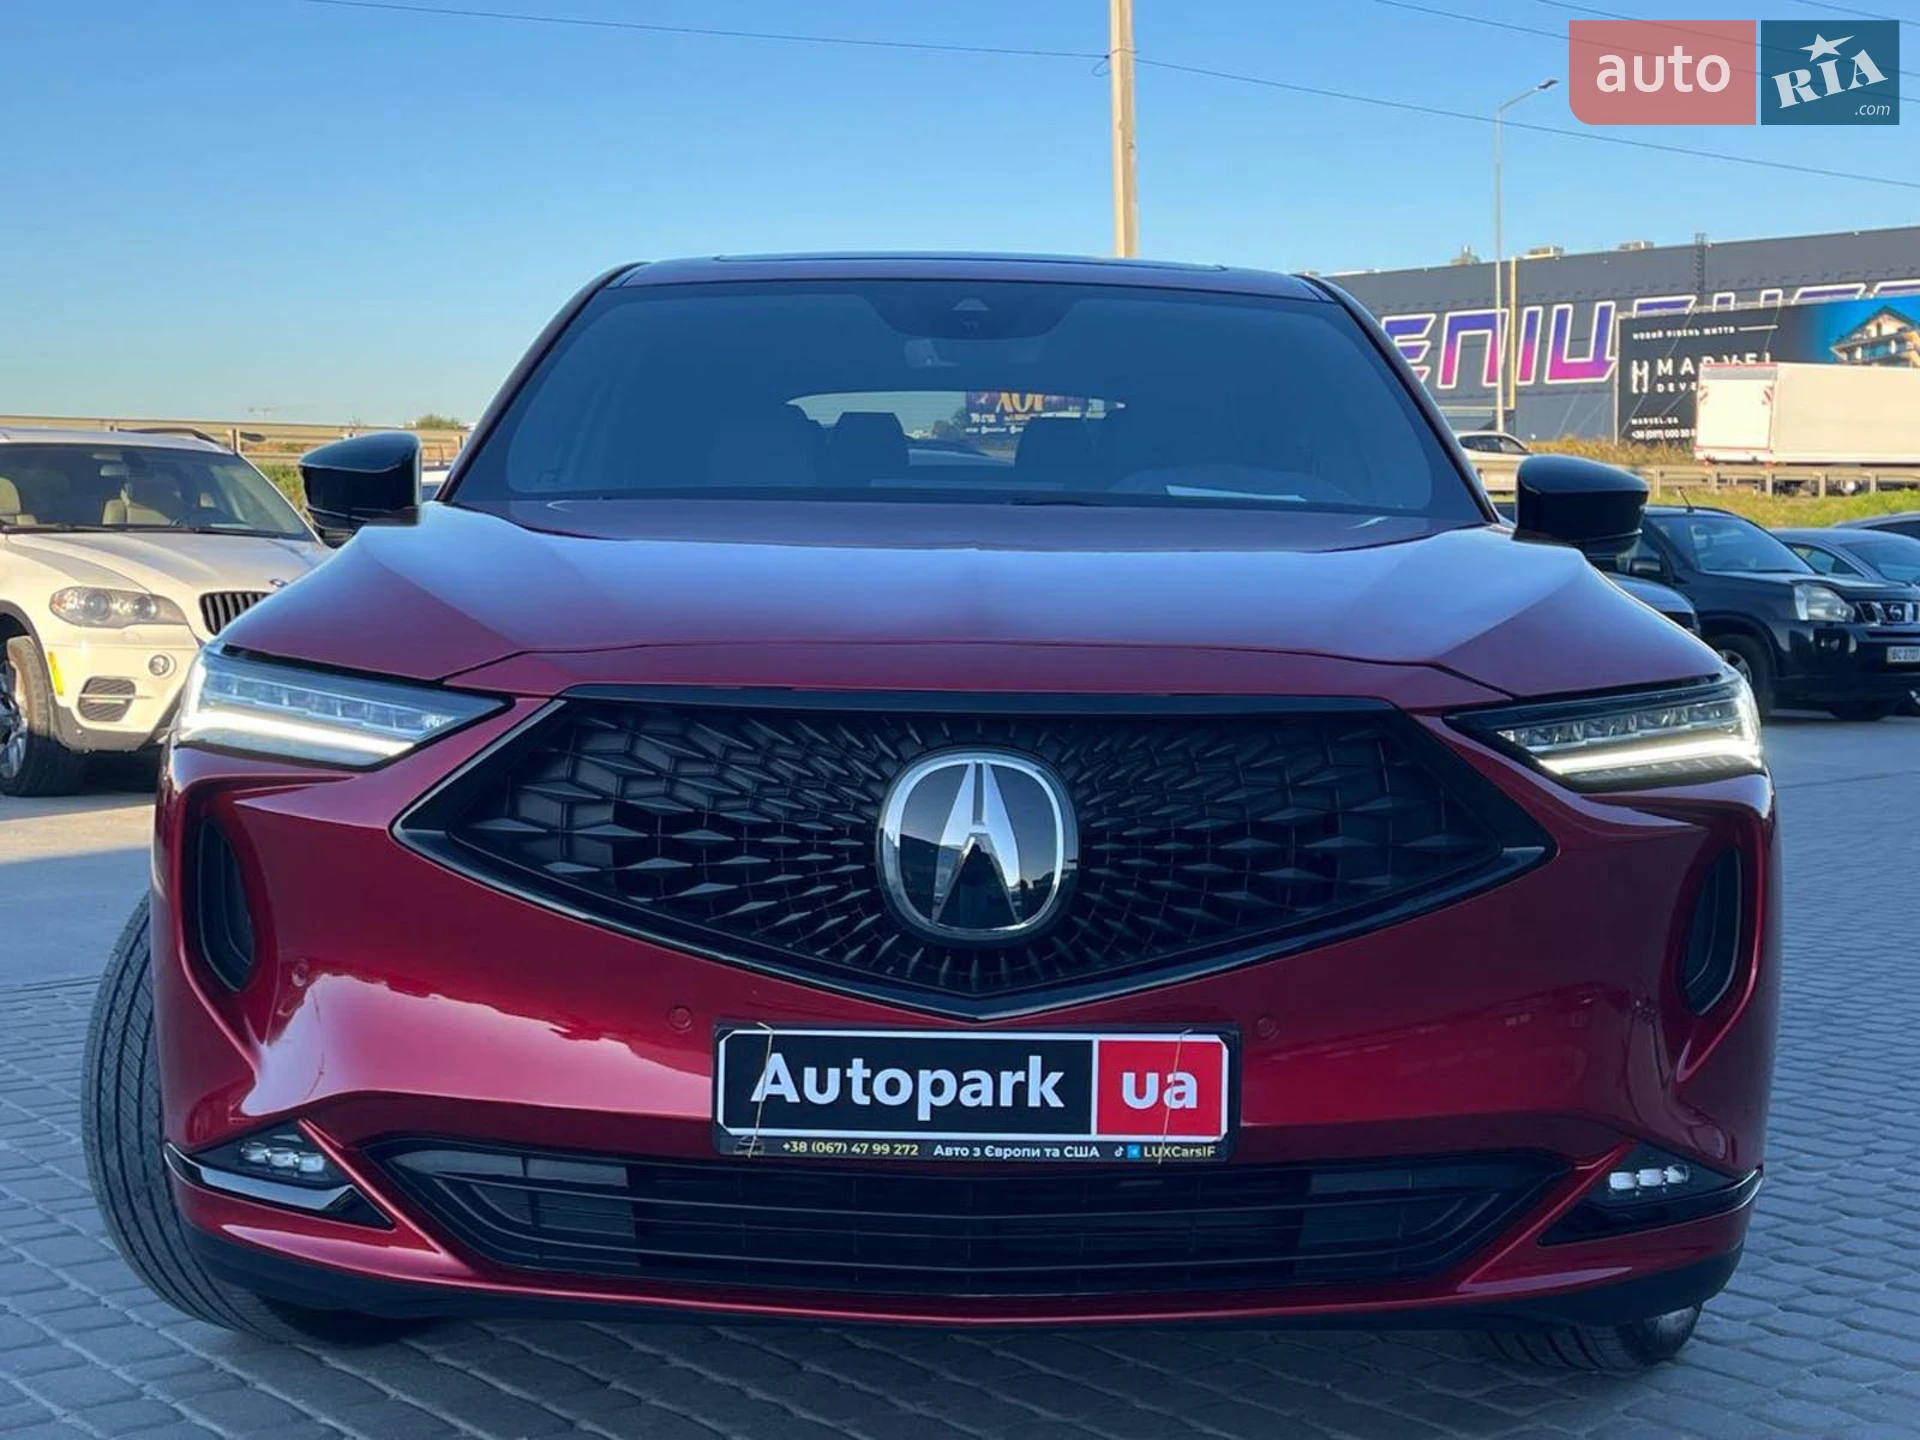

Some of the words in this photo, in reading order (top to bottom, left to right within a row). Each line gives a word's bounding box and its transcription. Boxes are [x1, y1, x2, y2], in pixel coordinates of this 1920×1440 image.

[1657, 382, 1697, 393] DEVE
[751, 1052, 1065, 1121] Autopark
[1122, 1071, 1198, 1110] ua
[783, 1141, 808, 1153] +38
[811, 1140, 847, 1154] (067)
[851, 1142, 869, 1154] 47
[872, 1143, 890, 1154] 99
[894, 1144, 919, 1155] 272
[933, 1144, 969, 1157] Авто
[984, 1145, 1041, 1160] Європи
[1044, 1148, 1060, 1158] та
[1063, 1146, 1100, 1158] США
